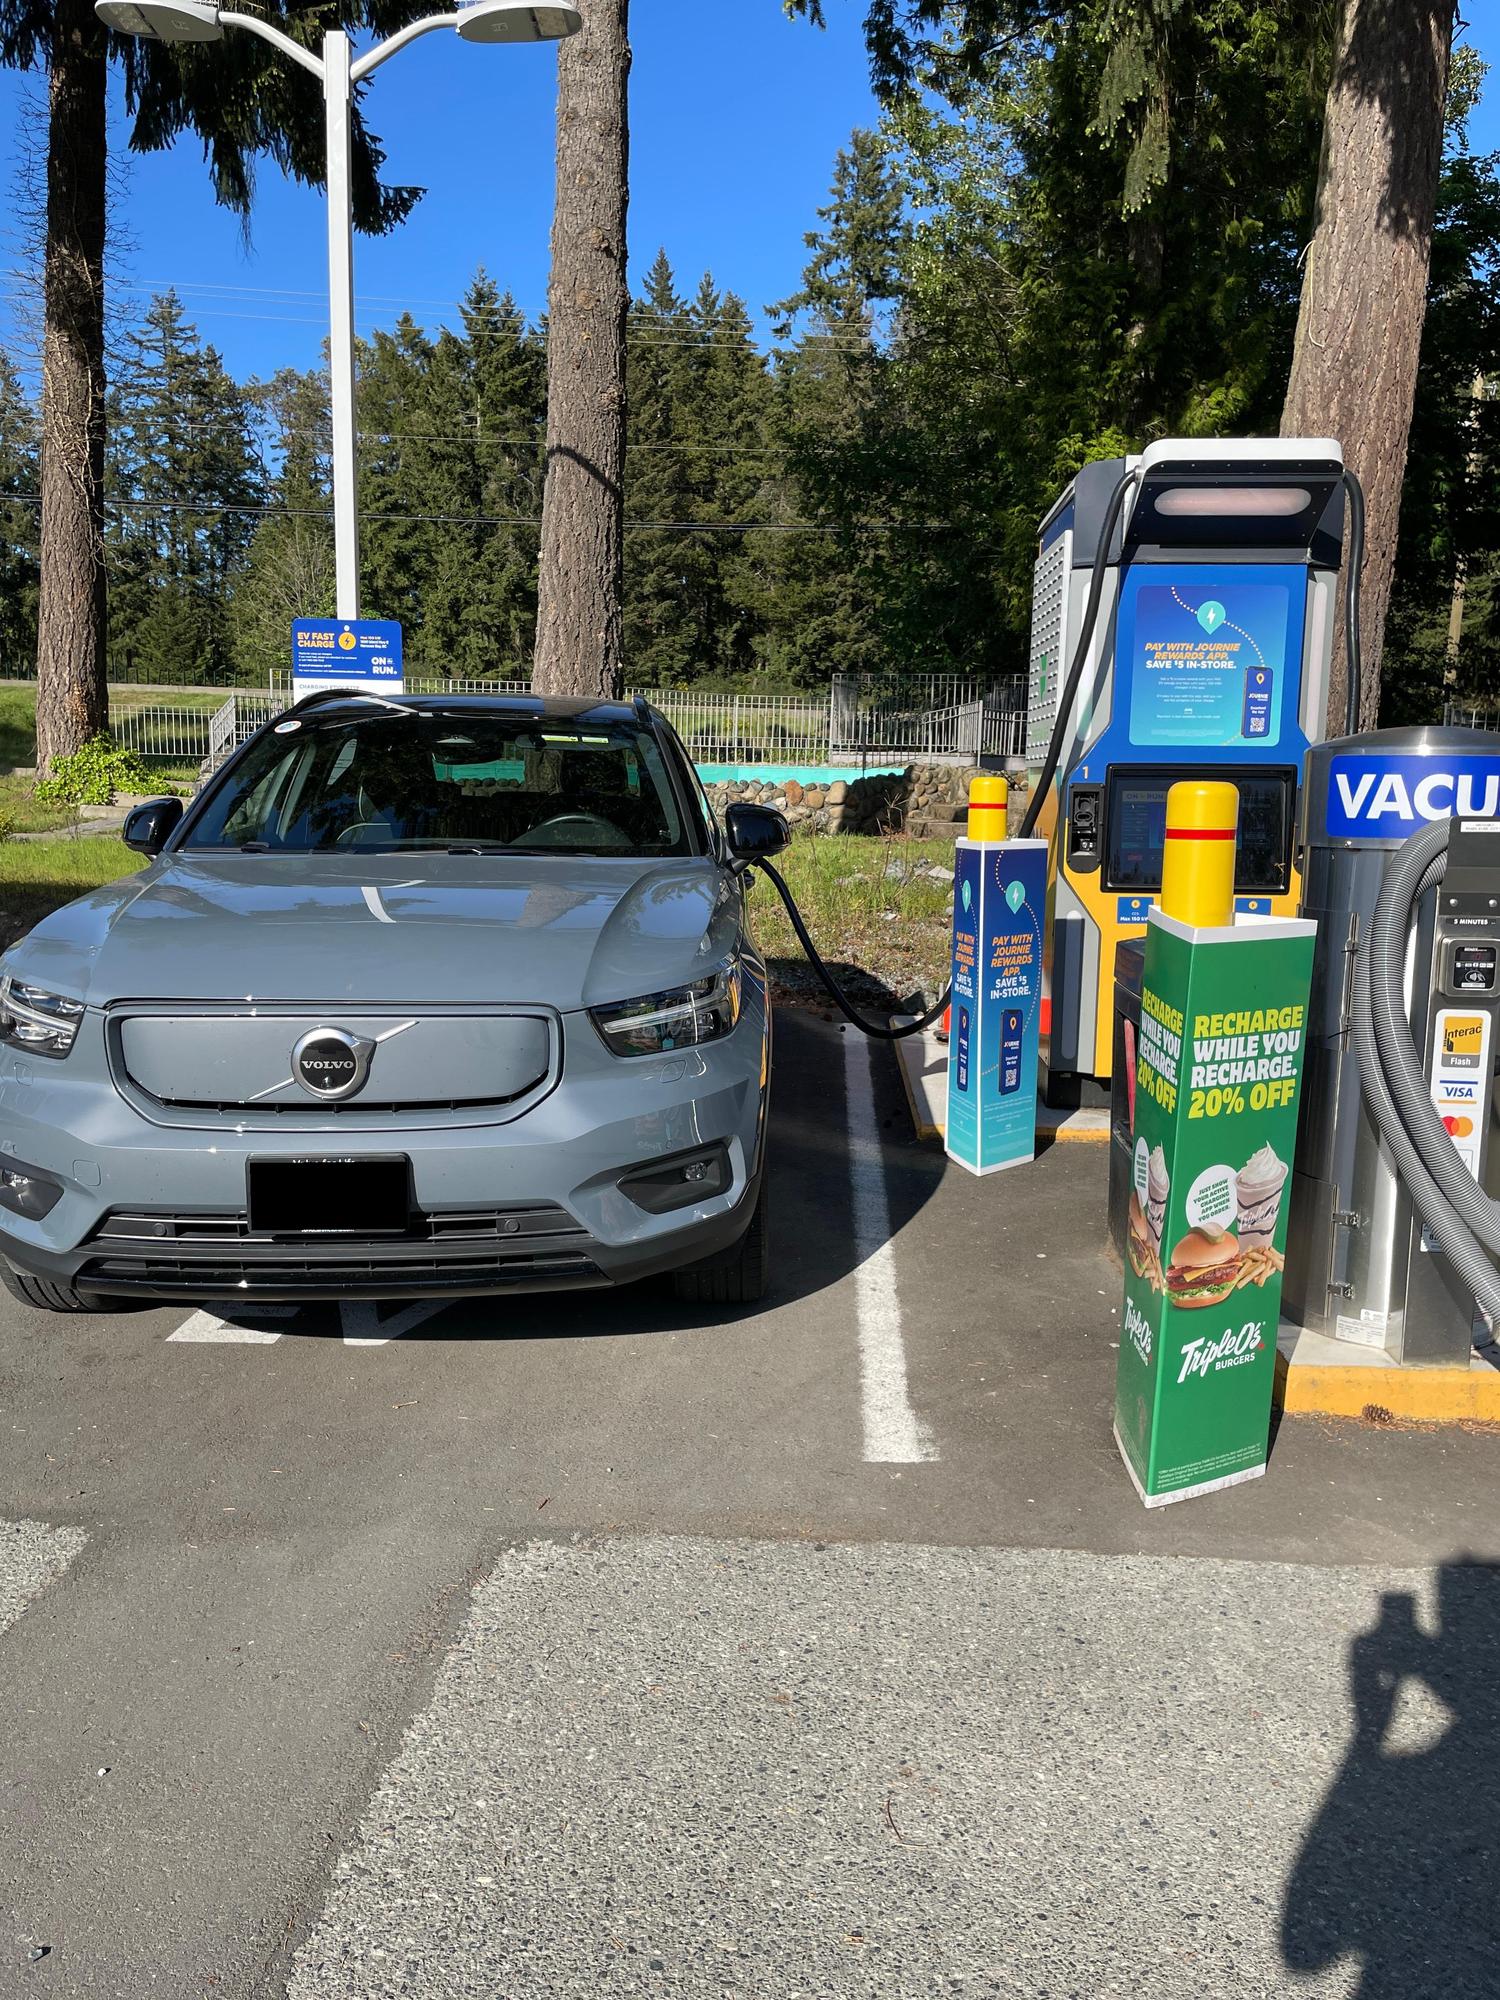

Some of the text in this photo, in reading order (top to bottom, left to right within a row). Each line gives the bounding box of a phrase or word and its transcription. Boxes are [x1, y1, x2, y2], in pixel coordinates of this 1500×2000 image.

[297, 632, 335, 641] EV FAST
[297, 640, 335, 649] CHARGE
[1145, 643, 1241, 651] PAY WITH JOURNIE
[371, 657, 386, 665] ON
[1154, 651, 1229, 660] REWARDS APP.
[1146, 660, 1237, 669] SAVE $5 IN-STORE.
[1082, 766, 1089, 779] 1
[956, 931, 964, 942] PAY
[992, 934, 1033, 947] PAY WITH
[993, 944, 1031, 957] JOURNIE
[991, 954, 1033, 968] REWARDS
[1002, 966, 1021, 977] APP.
[995, 975, 1027, 989] SAVE $5
[990, 985, 1031, 1000] IN-STORE.
[1142, 987, 1184, 1037] RECHARGE
[1193, 1005, 1304, 1039] RECHARGE
[1141, 1010, 1181, 1061] WHILE YOU
[1444, 1026, 1482, 1039] Interac
[1193, 1030, 1301, 1062] WHILE YOU
[301, 1060, 354, 1069] VOLVO
[1139, 1033, 1178, 1086] RECHARGE.
[1450, 1057, 1471, 1066] Flash
[1190, 1055, 1297, 1089] RECHARGE.
[1137, 1056, 1177, 1115] 20% OFF
[1188, 1079, 1296, 1119] 20% OFF
[1443, 1087, 1473, 1098] VISA
[1199, 1178, 1228, 1195] JUST SHOW
[1193, 1184, 1229, 1204] YOUR ACTIVE
[1200, 1191, 1230, 1208] CHARGING
[1201, 1197, 1230, 1215] APP WHEN
[1198, 1213, 1210, 1222] YOU
[1215, 1352, 1256, 1371] BURGERS
